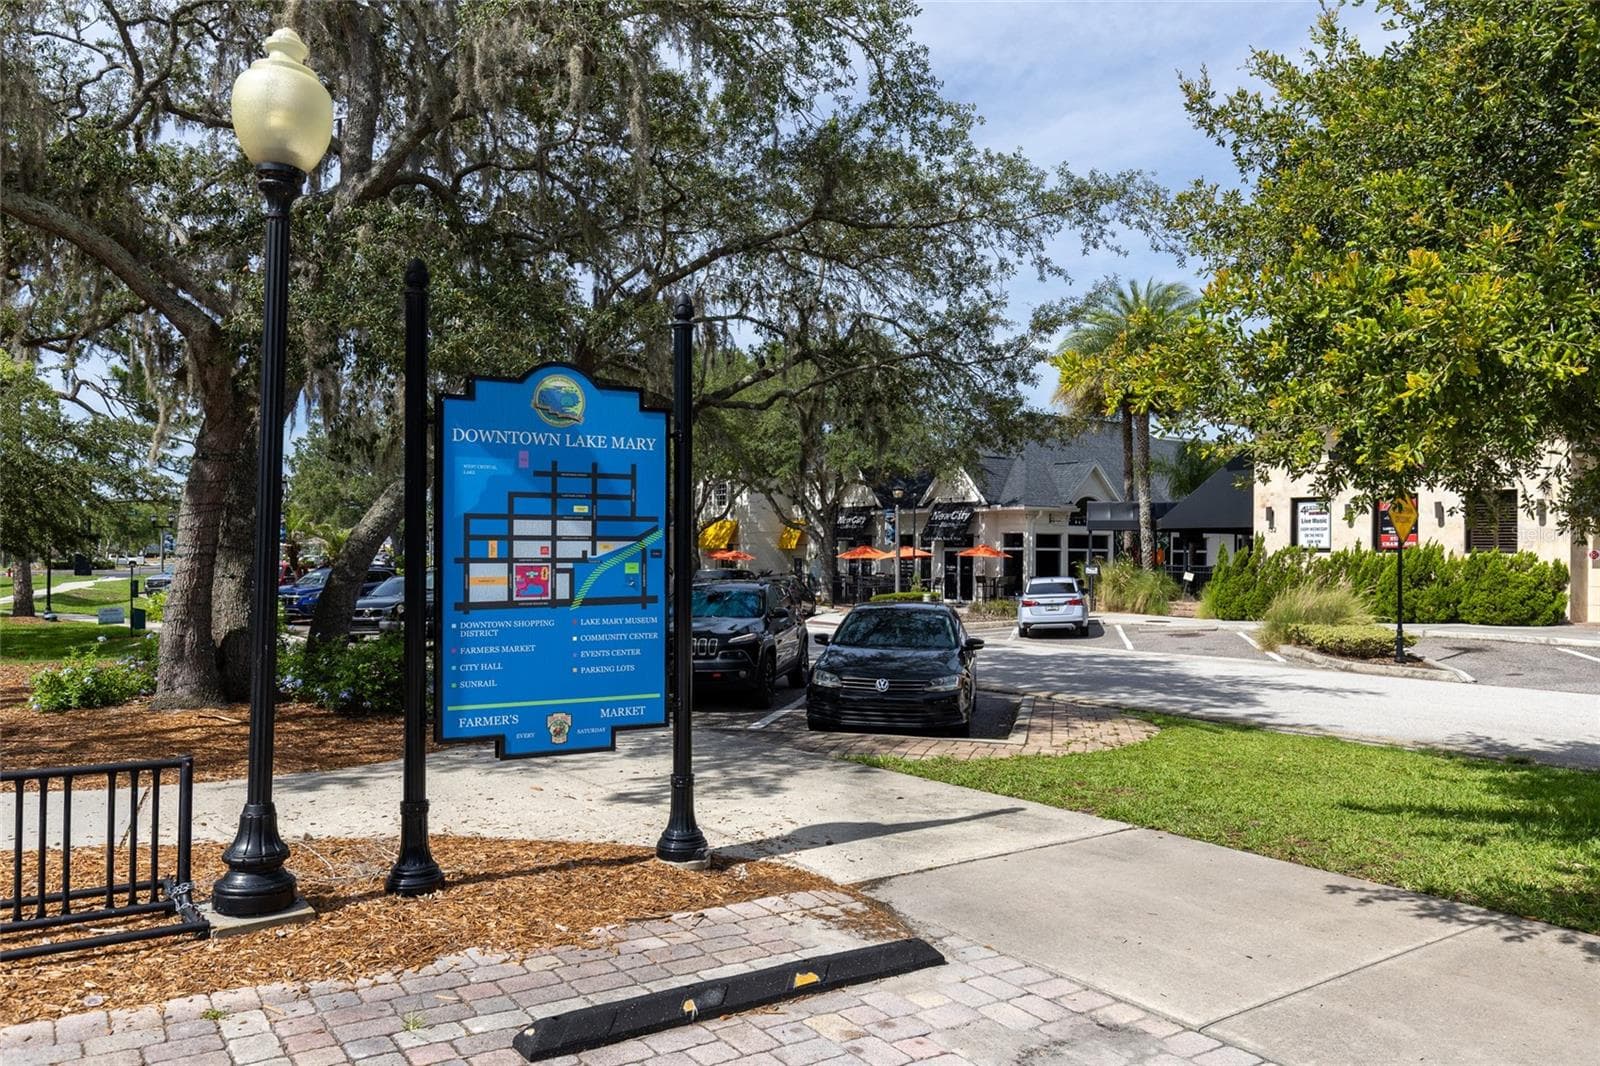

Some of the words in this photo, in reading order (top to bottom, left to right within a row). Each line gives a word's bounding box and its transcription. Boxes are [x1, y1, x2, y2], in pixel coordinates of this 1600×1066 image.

[452, 428, 560, 446] DOWNTOWN
[566, 434, 607, 448] LAKE
[612, 436, 656, 450] MARY
[460, 646, 499, 654] FARMERS
[501, 645, 536, 653] MARKET
[581, 665, 614, 673] PARKING
[460, 680, 497, 688] SUNRAIL
[459, 714, 519, 728] FARMER'S
[600, 706, 646, 718] MARKET
